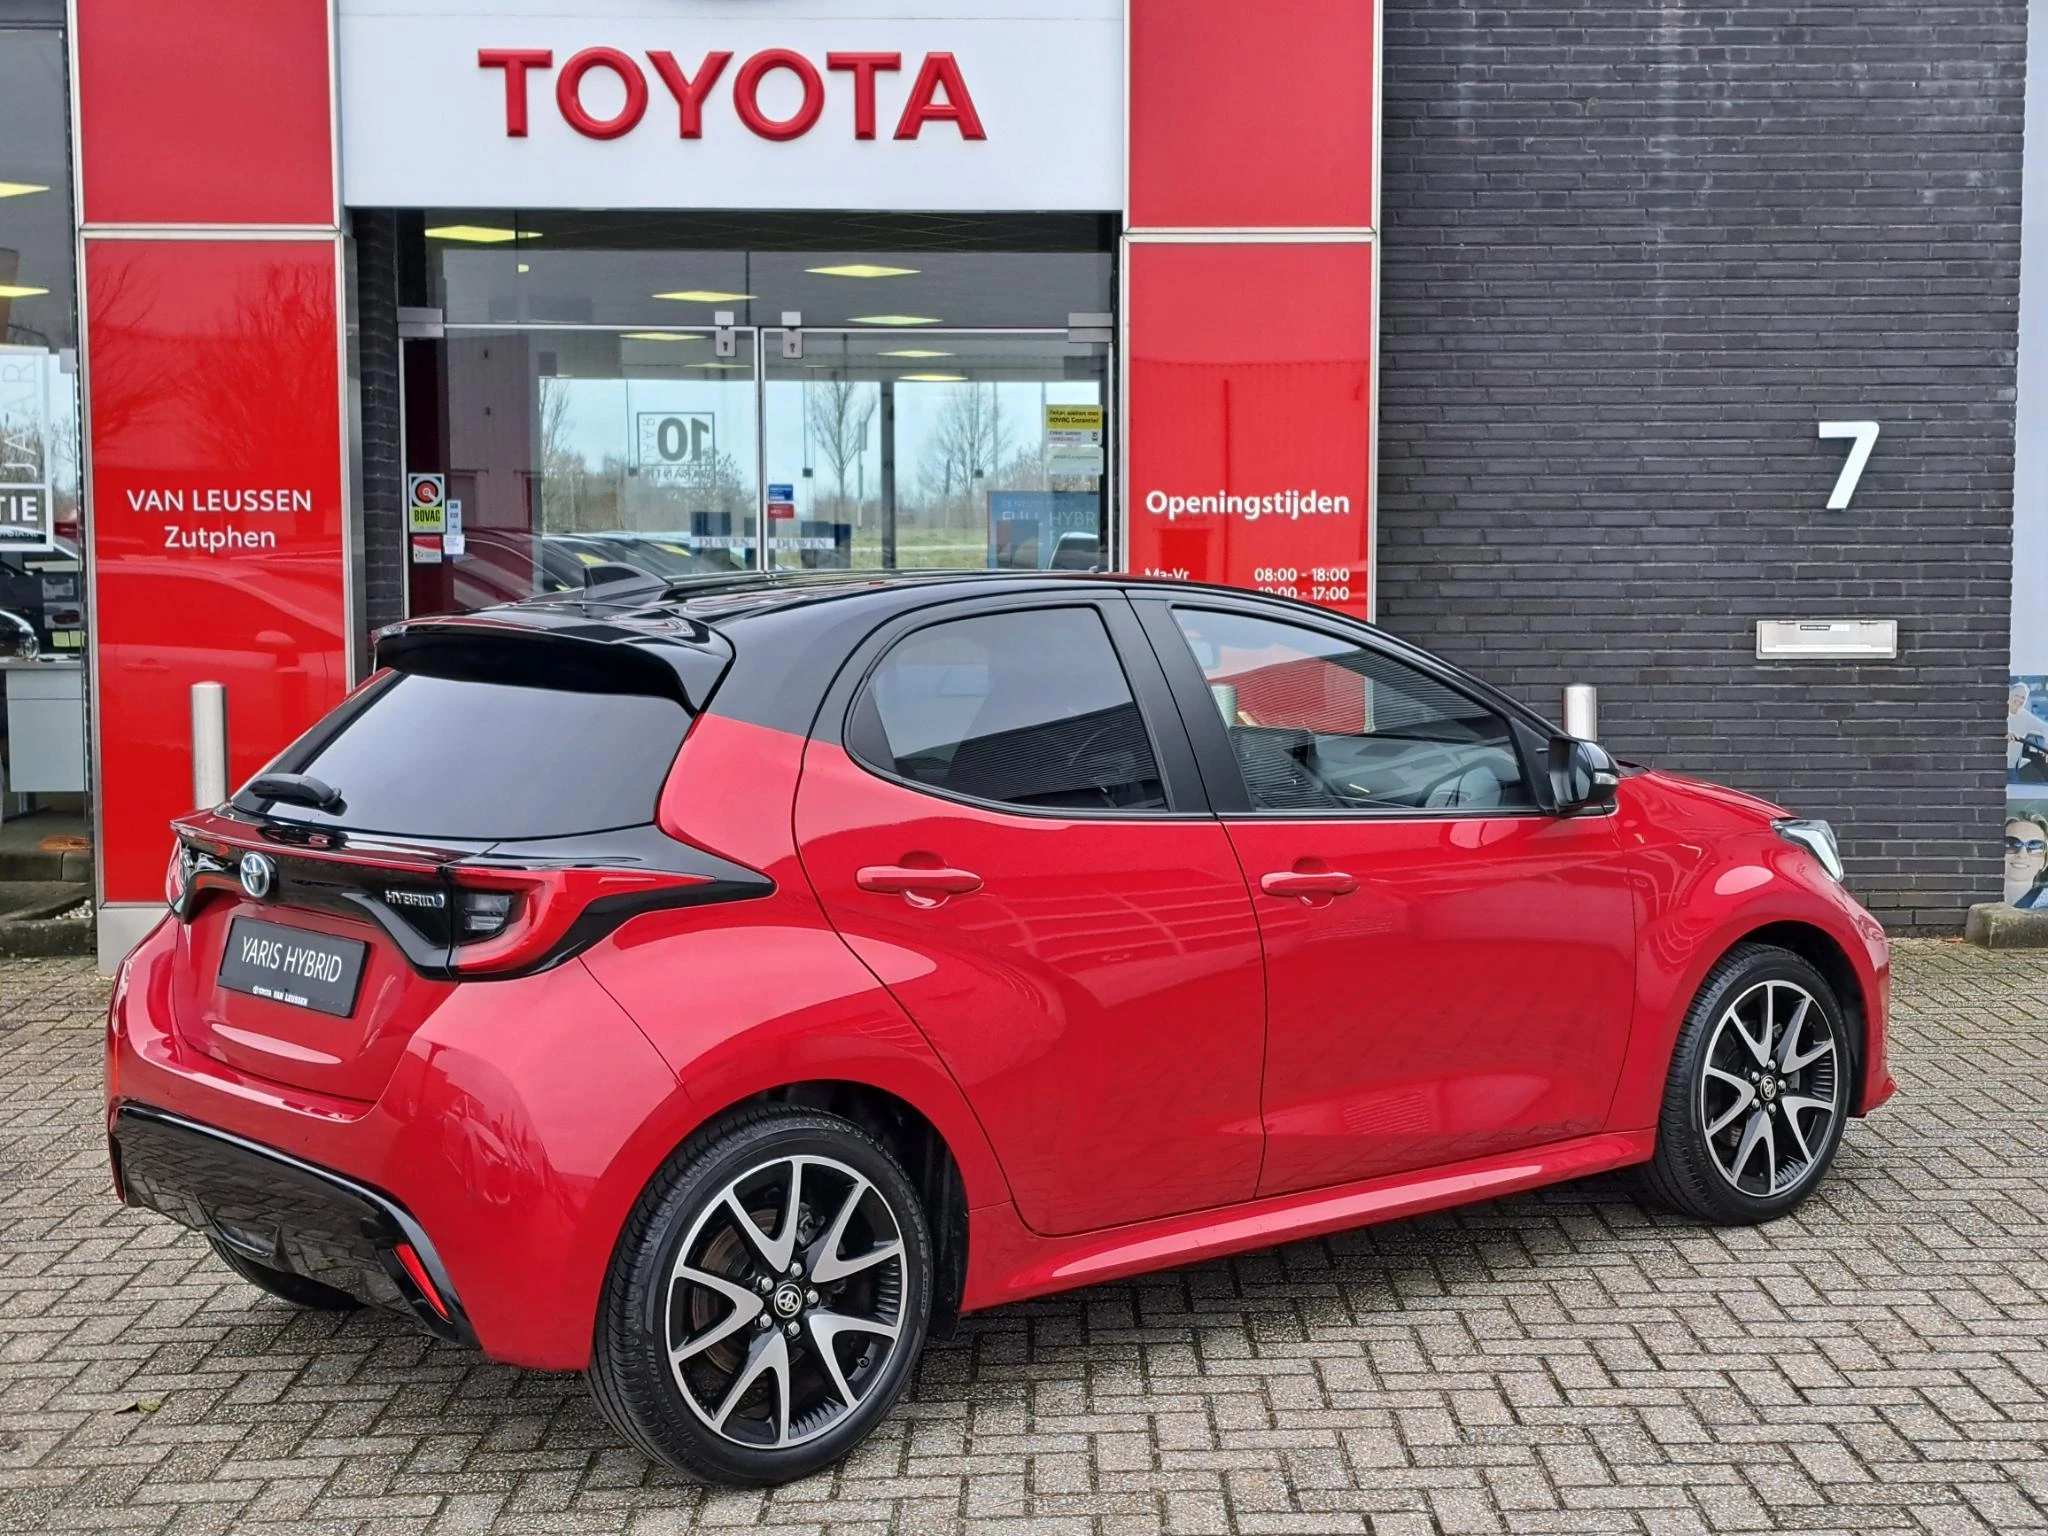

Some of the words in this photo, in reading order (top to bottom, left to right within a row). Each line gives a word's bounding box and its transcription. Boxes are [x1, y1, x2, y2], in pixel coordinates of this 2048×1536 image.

[478, 46, 988, 142] TOYOTA
[1818, 421, 1880, 510] 7
[126, 490, 184, 512] VAN
[192, 489, 312, 513] LEUSSEN
[1145, 490, 1351, 521] Openingstijden
[414, 510, 441, 522] BOVAG
[164, 525, 276, 554] Zutphen
[1254, 567, 1298, 582] 08:00
[1311, 567, 1350, 582] 18:00
[1311, 586, 1350, 601] 17:00
[384, 890, 436, 908] HYBRID
[241, 936, 283, 970] YARIS
[283, 945, 342, 983] HYBRID
